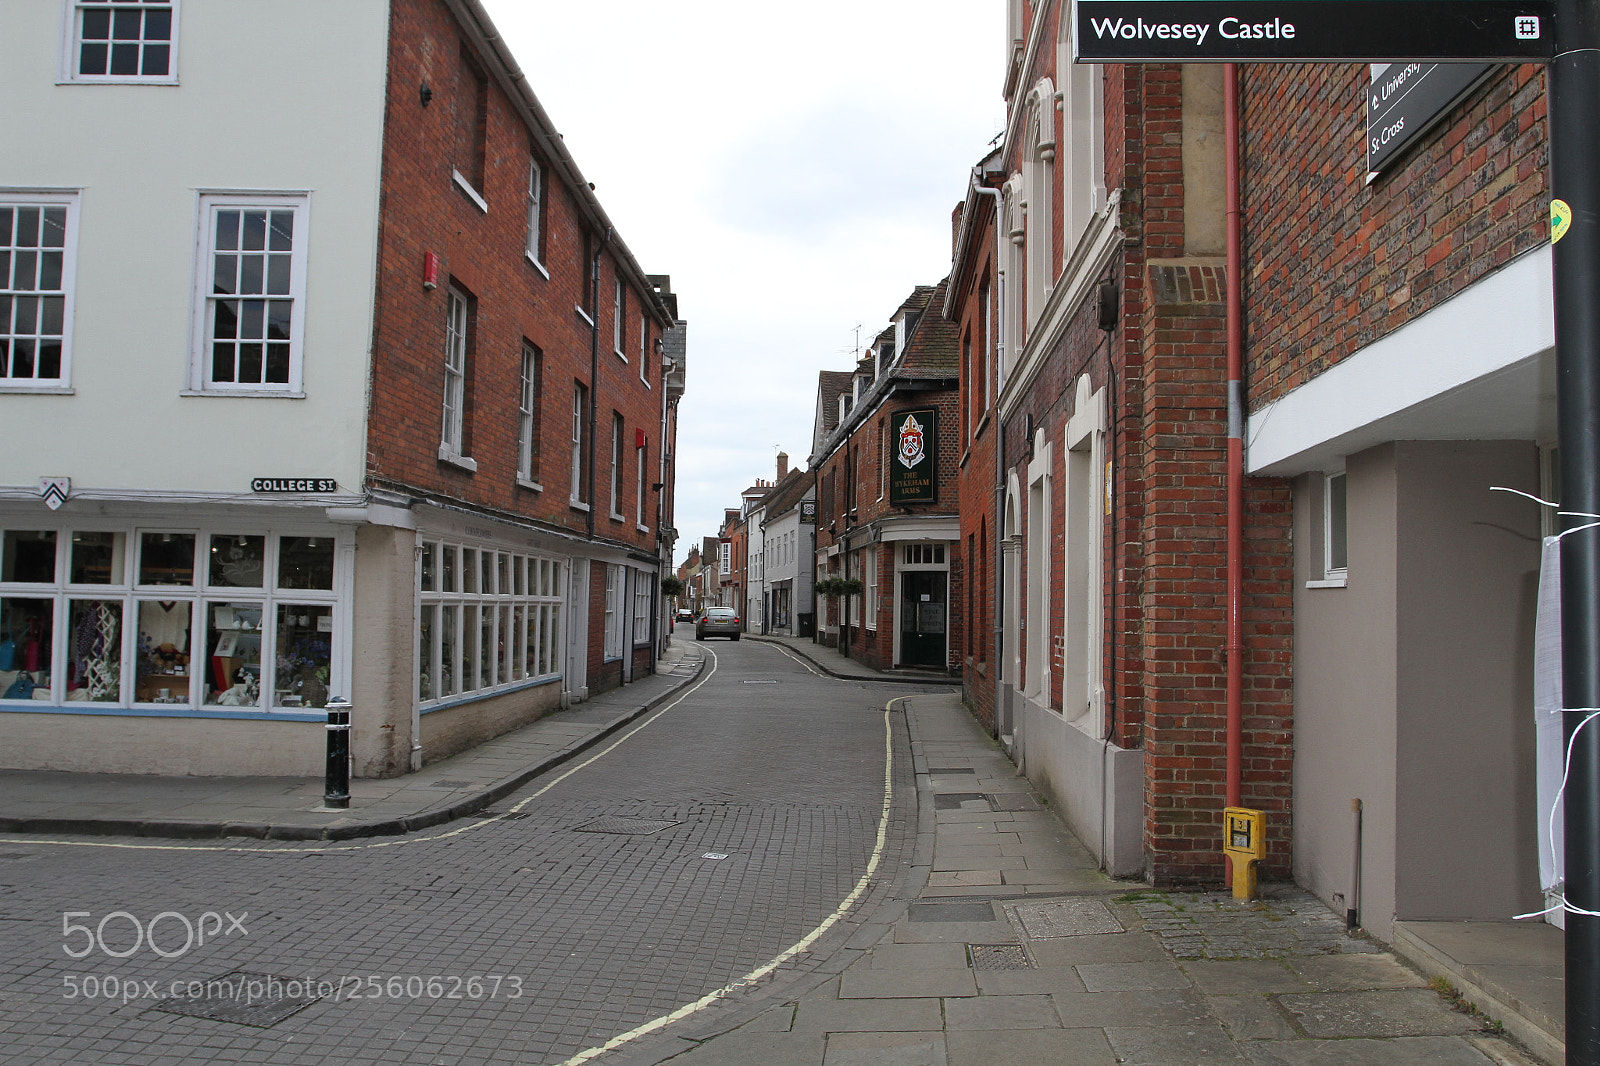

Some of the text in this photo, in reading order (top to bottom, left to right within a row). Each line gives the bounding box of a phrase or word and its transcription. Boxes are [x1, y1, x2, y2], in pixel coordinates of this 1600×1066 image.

[1090, 17, 1296, 46] Wolvesey Castle
[1371, 116, 1405, 155] St Cross
[253, 480, 314, 491] COLLEGE
